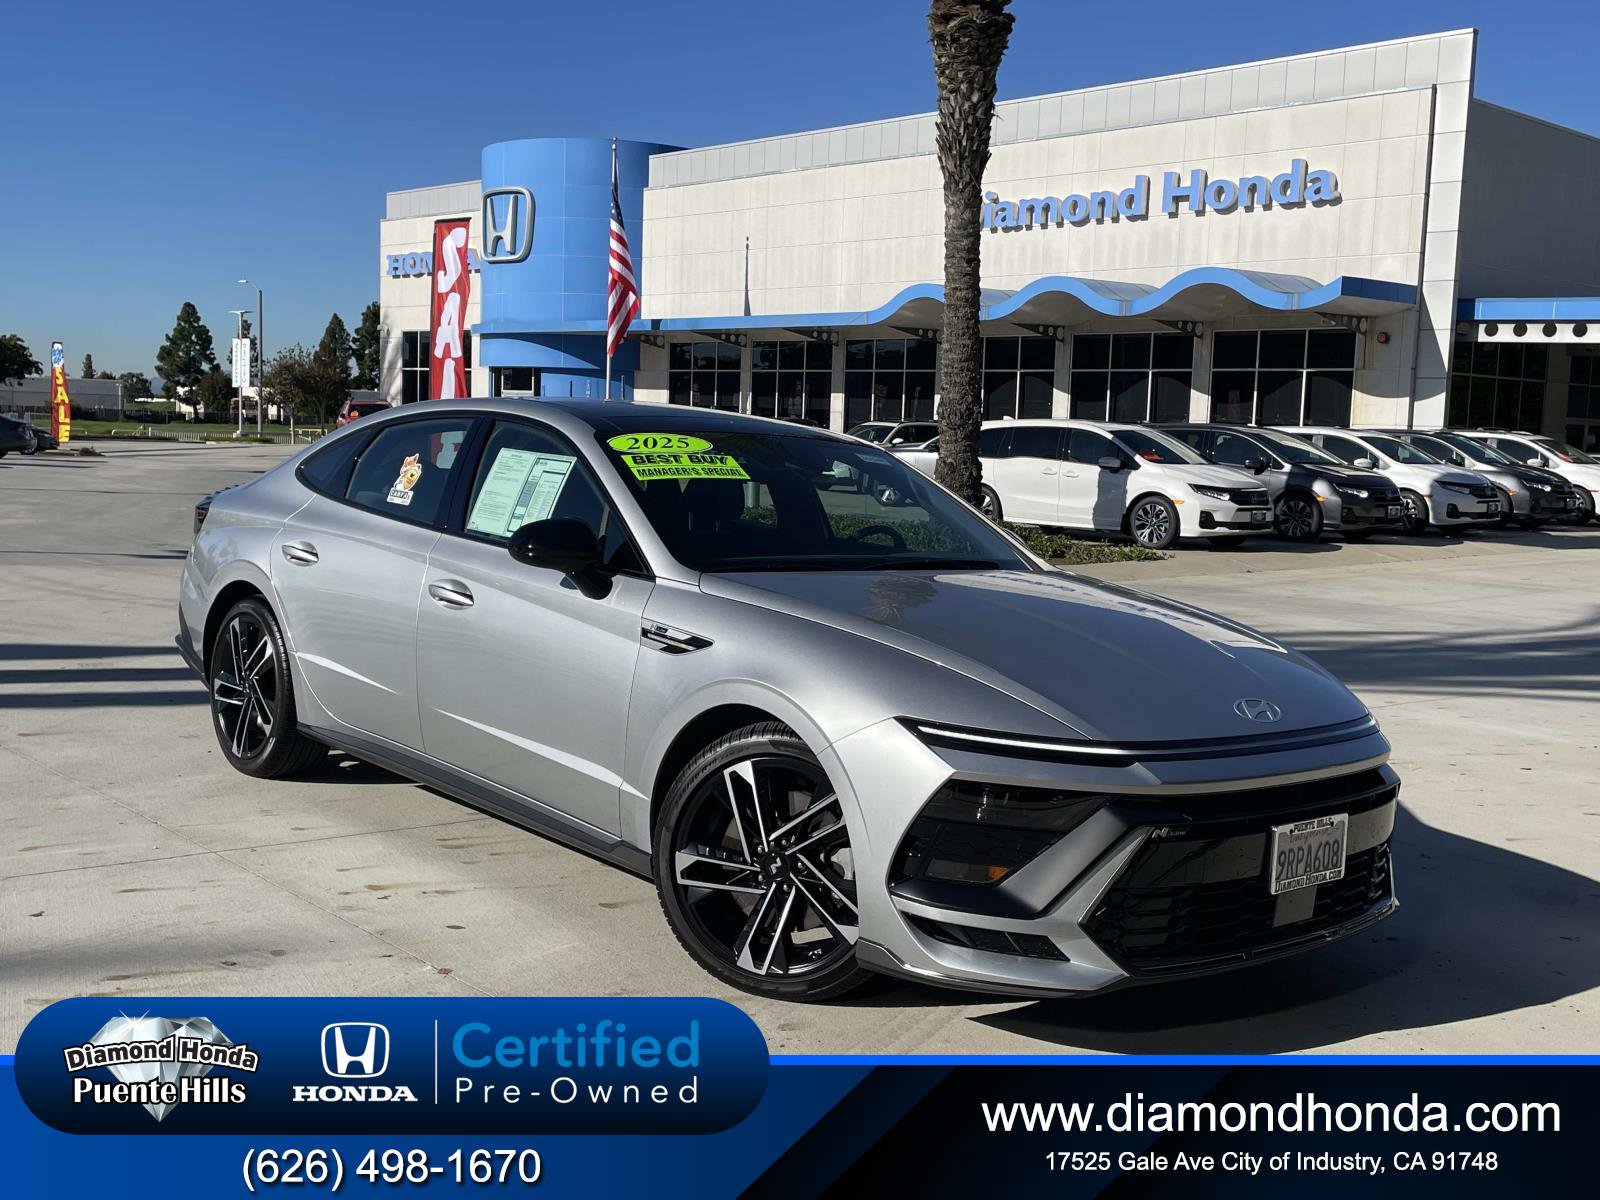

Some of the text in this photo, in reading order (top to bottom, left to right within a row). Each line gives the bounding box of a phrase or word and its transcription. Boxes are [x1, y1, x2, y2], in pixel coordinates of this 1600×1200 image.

[982, 158, 1339, 230] iamond Honda
[387, 249, 480, 277] HONA
[55, 367, 70, 442] SALE
[627, 437, 689, 449] 2025
[631, 454, 728, 465] BEST BUY
[637, 467, 746, 478] MANAGER'S SPECIAL
[1276, 838, 1340, 880] 9RPA608
[1275, 876, 1305, 892] DIAMOND
